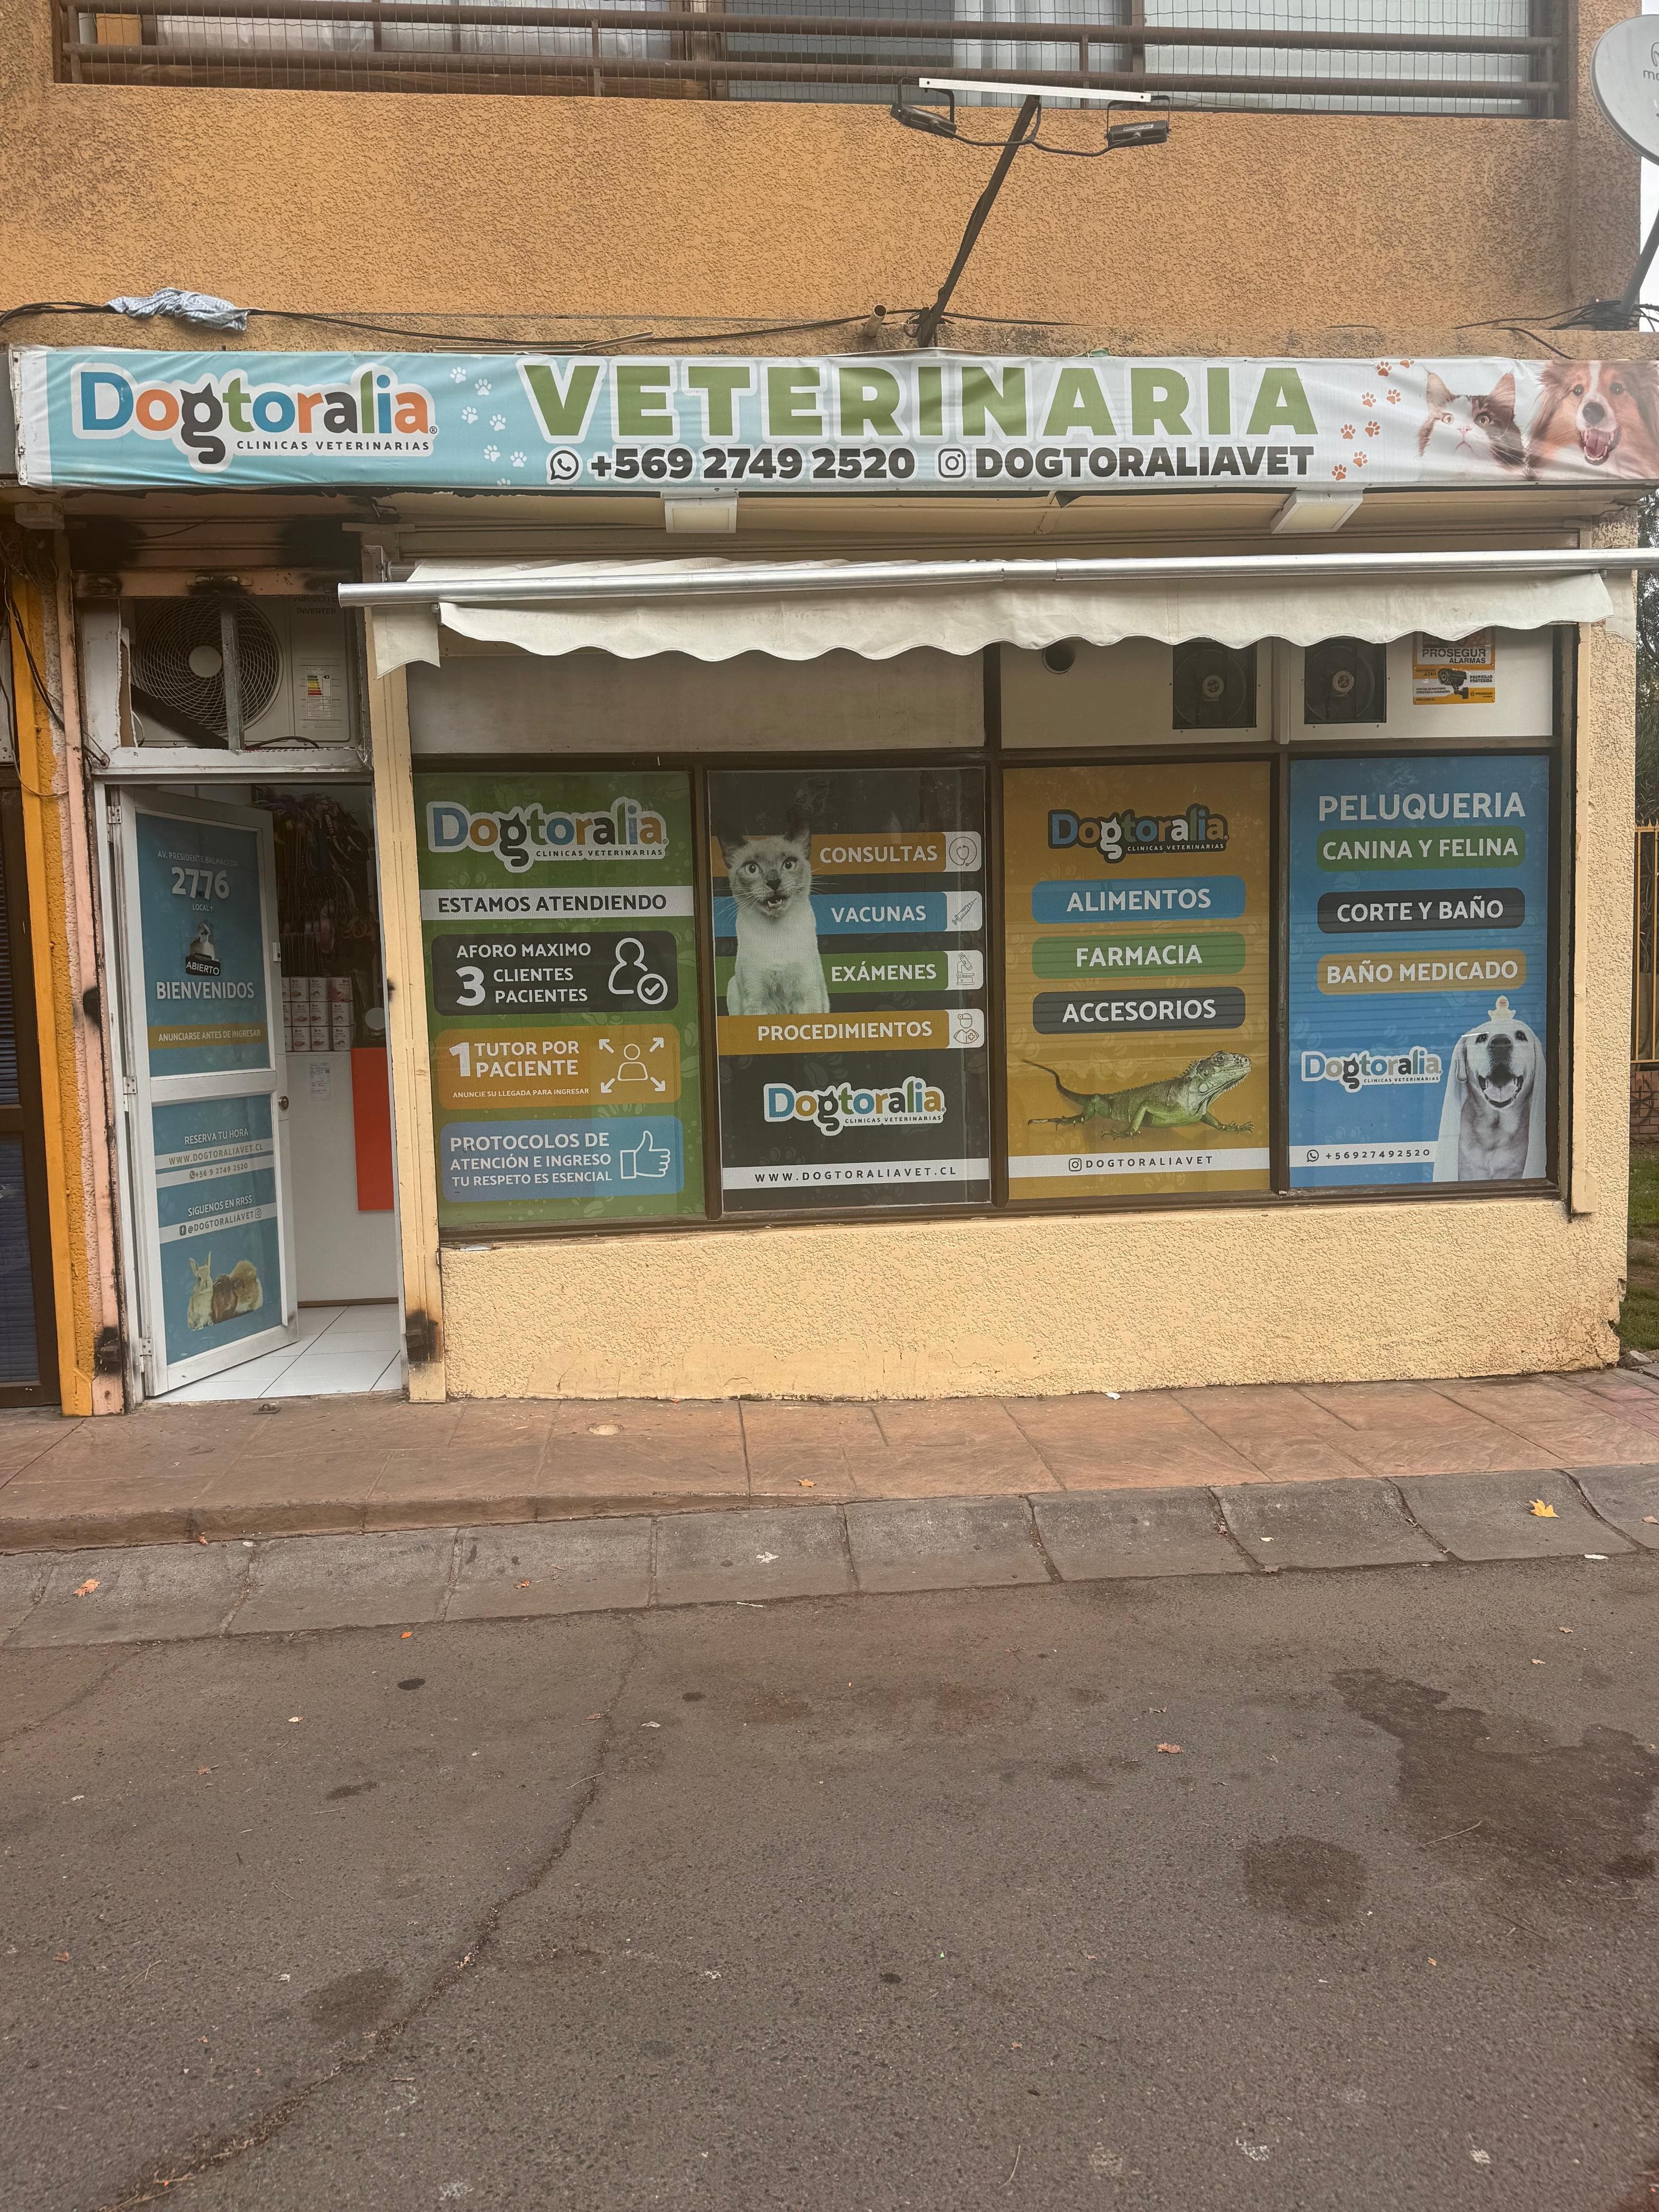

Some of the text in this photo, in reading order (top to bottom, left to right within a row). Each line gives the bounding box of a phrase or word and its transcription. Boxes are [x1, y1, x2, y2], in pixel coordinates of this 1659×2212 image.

[524, 365, 1318, 437] VETERINARIA
[80, 371, 429, 464] Dogtoralia
[237, 440, 430, 451] CLINICAS VETERINARIAS
[591, 447, 915, 479] +569 2749 2520
[976, 446, 1314, 478] DOGTORALIAVET
[1422, 648, 1486, 658] PROSEGUR
[1319, 792, 1526, 821] PELUQUERIA
[433, 802, 663, 867] Dogtoralia
[1051, 807, 1224, 860] Dogtoralia
[169, 852, 205, 864] PRESIDENTE
[819, 845, 938, 864] CONSULTAS
[1322, 837, 1519, 860] CANINA Y FELINA
[171, 866, 230, 900] 2776
[192, 903, 210, 912] LOCAL
[438, 894, 667, 913] ESTAMOS ATENDIENDO
[1066, 888, 1211, 912] ALIMENTOS
[1336, 895, 1504, 923] CORTE Y BAÑO
[831, 905, 926, 923] VACUNAS
[456, 942, 591, 958] AFORO MAXIMO
[1076, 944, 1203, 967] FARMACIA
[186, 960, 220, 975] ABIERTO
[493, 967, 574, 983] CLIENTES
[831, 961, 937, 982] EXÁMENES
[1326, 959, 1518, 984] BAÑO MEDICADO
[156, 982, 255, 1000] BIENVENIDOS
[456, 965, 486, 1007] 3
[495, 988, 588, 1003] PACIENTES
[1061, 999, 1217, 1023] ACCESORIOS
[158, 1032, 200, 1042] ANUNCIARSE
[202, 1030, 222, 1040] ANTES
[232, 1029, 261, 1038] INGRESAR
[758, 1021, 933, 1041] PROCEDIMIENTOS
[474, 1040, 580, 1057] TUTOR POR
[449, 1042, 471, 1077] 1
[476, 1059, 579, 1078] PACIENTE
[1305, 1049, 1439, 1090] Dogtoralia
[768, 1080, 941, 1132] Dogtoralia
[185, 1128, 249, 1145] RESERVA TU HORA
[450, 1133, 610, 1152] PROTOCOLOS DE
[169, 1144, 263, 1165] WWW.DOGTORALIAVET.CL
[450, 1153, 611, 1170] ATENCIÓN E INGRESO
[1086, 1155, 1213, 1169] DOGTORALIAVET
[1325, 1149, 1430, 1160] +56927492520
[215, 1166, 231, 1175] 2749
[233, 1163, 248, 1171] 2520
[755, 1166, 957, 1183] WWW.DOGTORALIAVET.CL
[452, 1171, 613, 1187] TU RESPETO ES ESENCIAL
[188, 1195, 253, 1217] SIGUENOS EN RRSS
[188, 1211, 254, 1234] @DOGTORALIAVET
